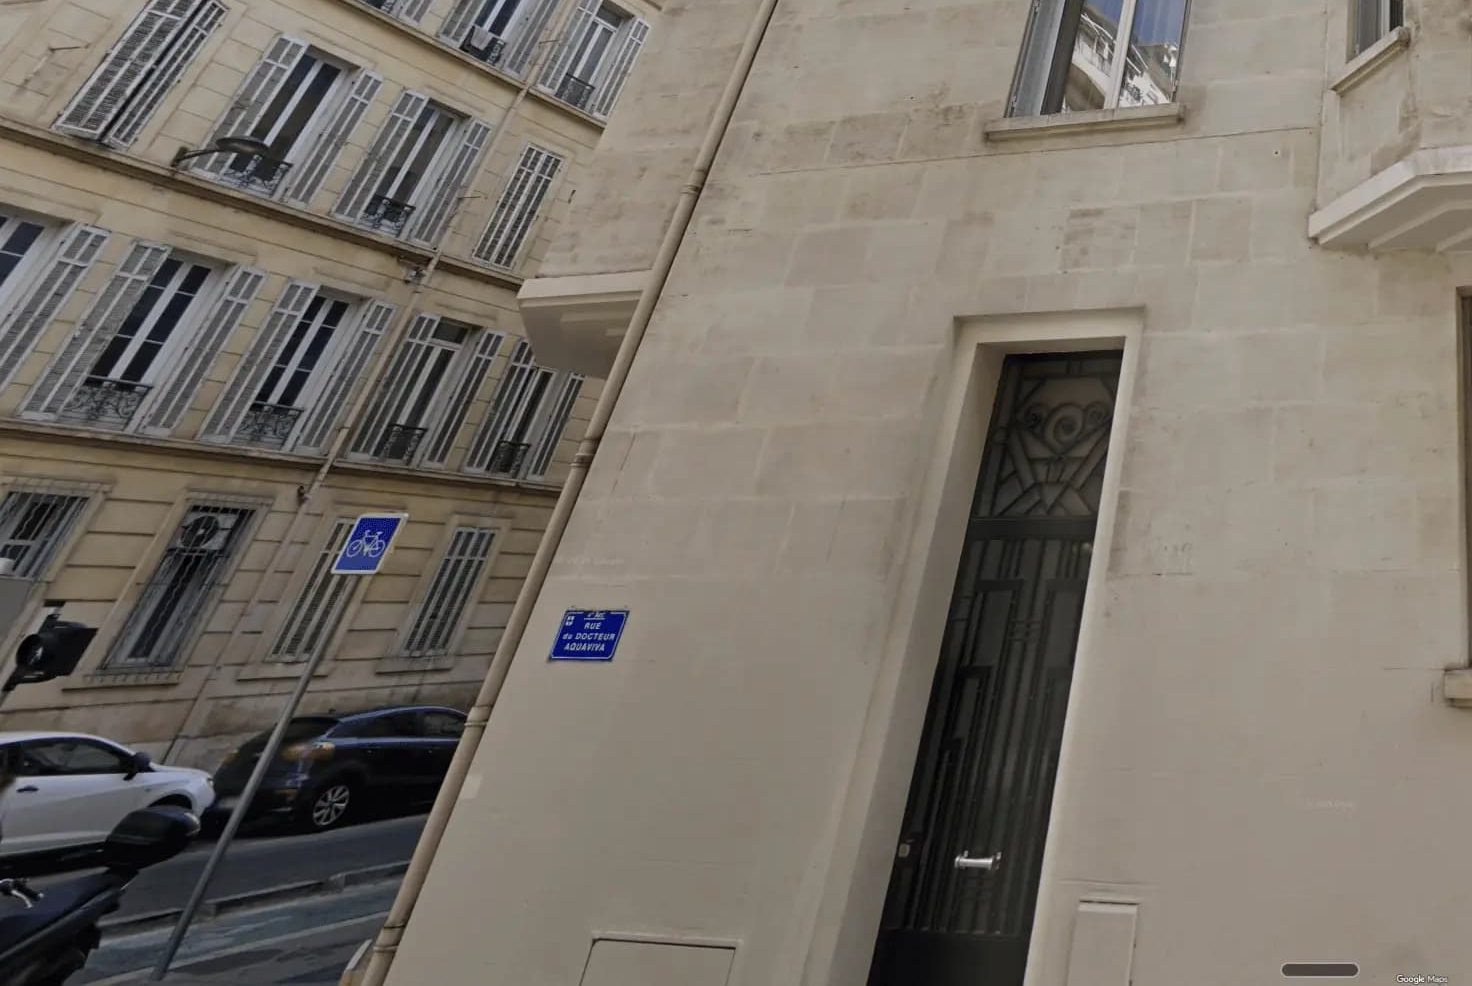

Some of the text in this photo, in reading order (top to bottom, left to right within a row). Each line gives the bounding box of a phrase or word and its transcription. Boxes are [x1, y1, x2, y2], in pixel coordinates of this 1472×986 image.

[584, 622, 602, 630] RUE
[575, 632, 616, 641] DOCTEUR
[563, 642, 605, 652] AQUAVIVA
